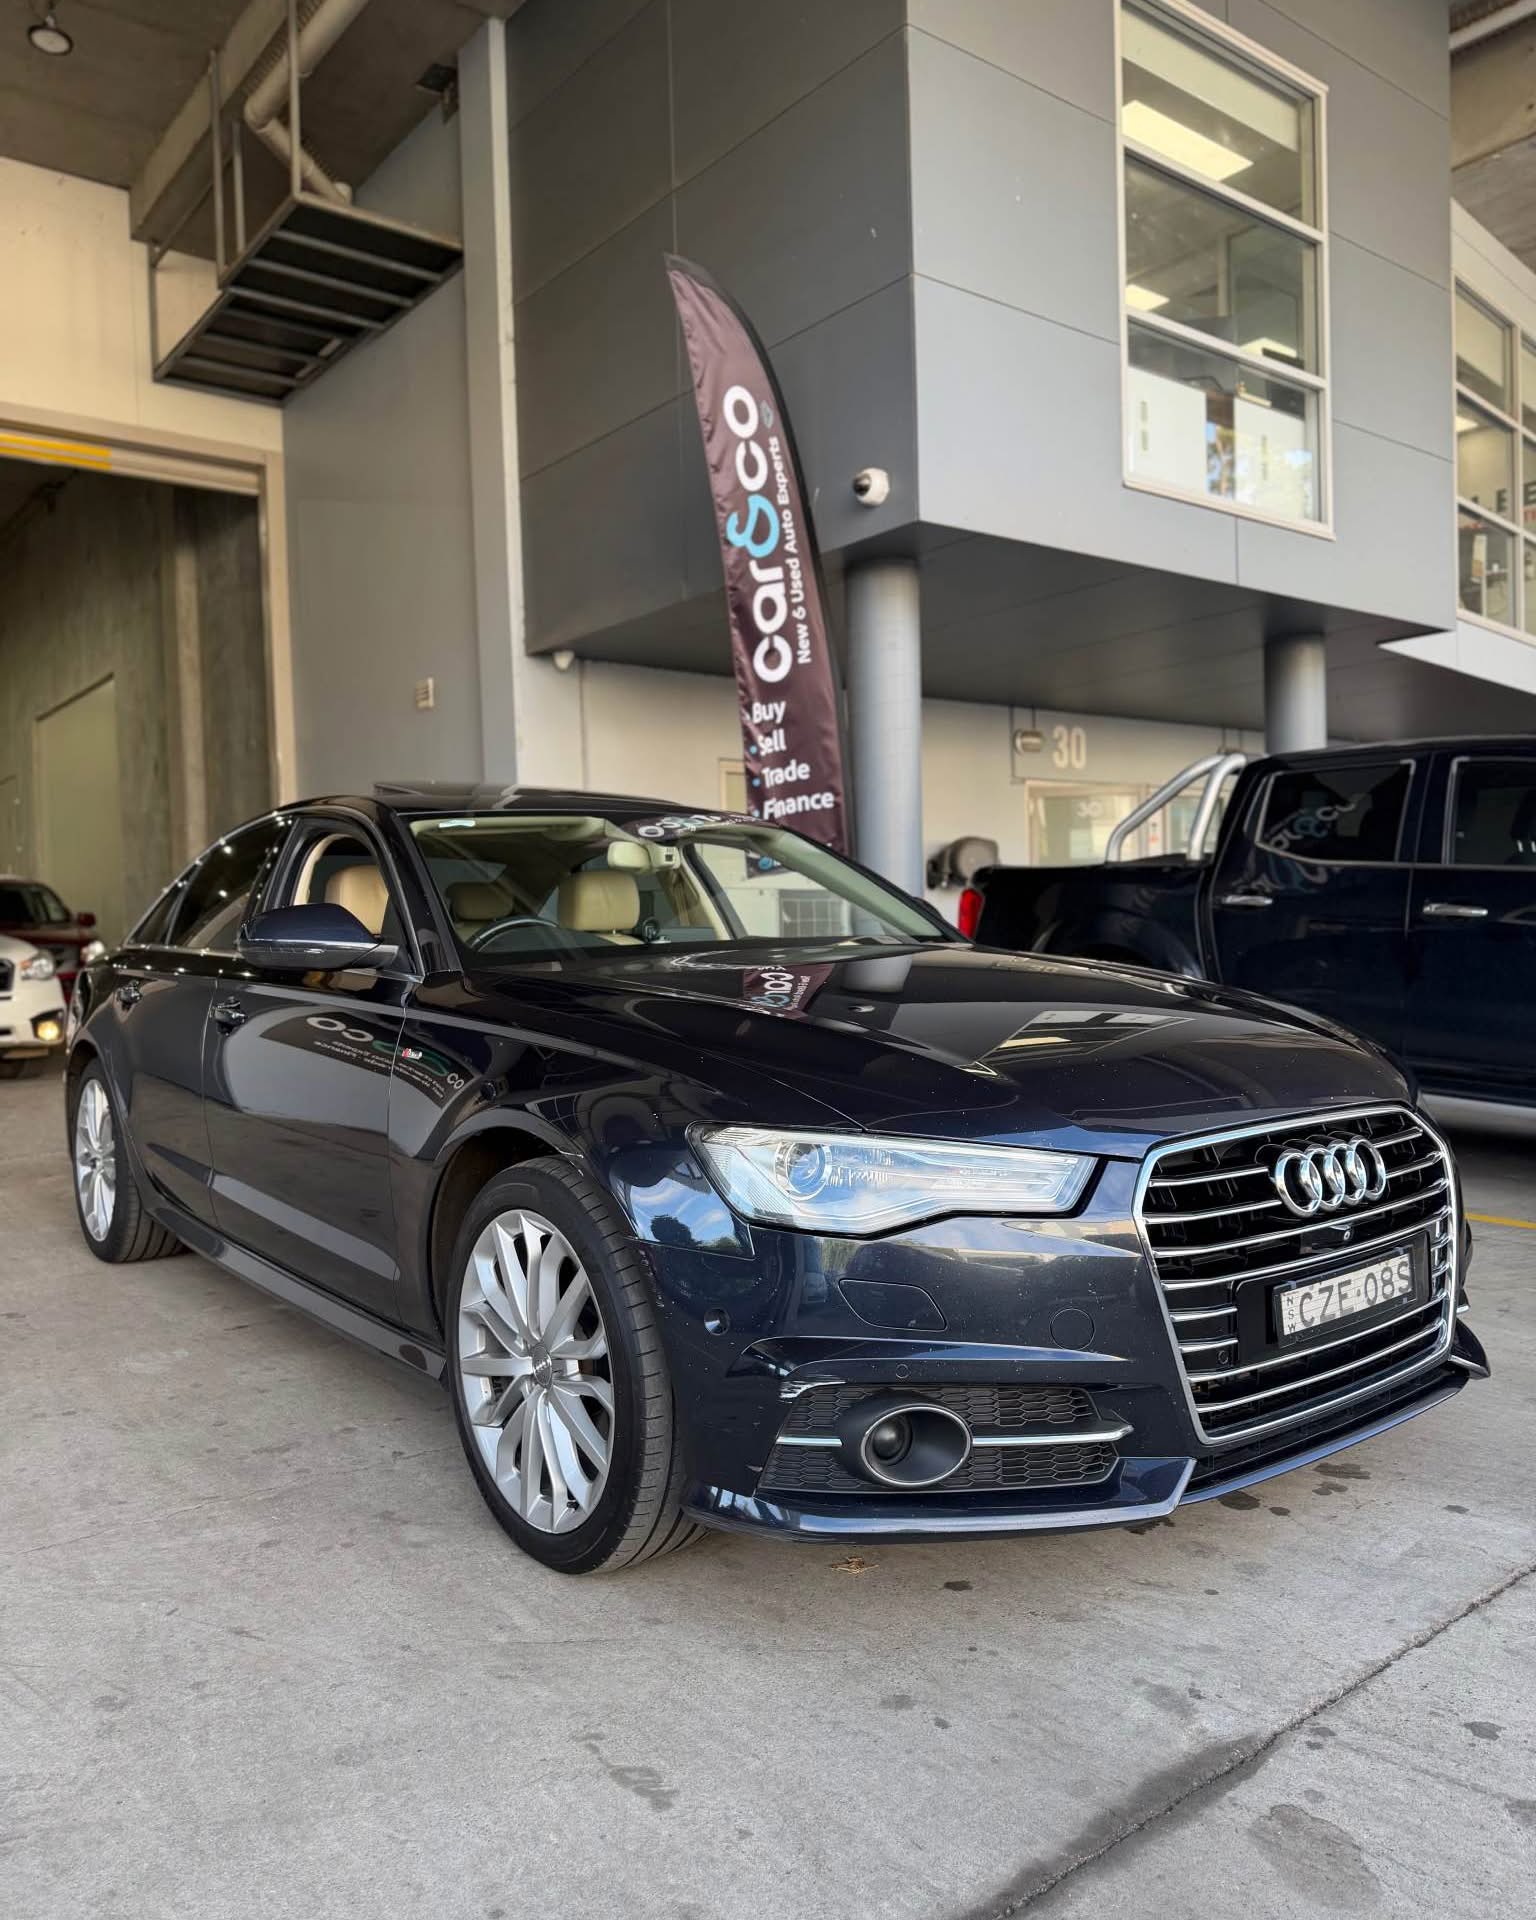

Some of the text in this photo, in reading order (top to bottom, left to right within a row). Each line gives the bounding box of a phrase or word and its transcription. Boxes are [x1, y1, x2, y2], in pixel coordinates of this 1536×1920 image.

[769, 436, 790, 505] Experts
[781, 510, 798, 553] Auto
[785, 558, 805, 603] Used
[797, 623, 811, 664] New
[752, 700, 786, 724] Buy
[758, 728, 787, 756] Sell
[1053, 725, 1087, 769] 30
[761, 759, 810, 788] Trade
[763, 792, 835, 820] Finance
